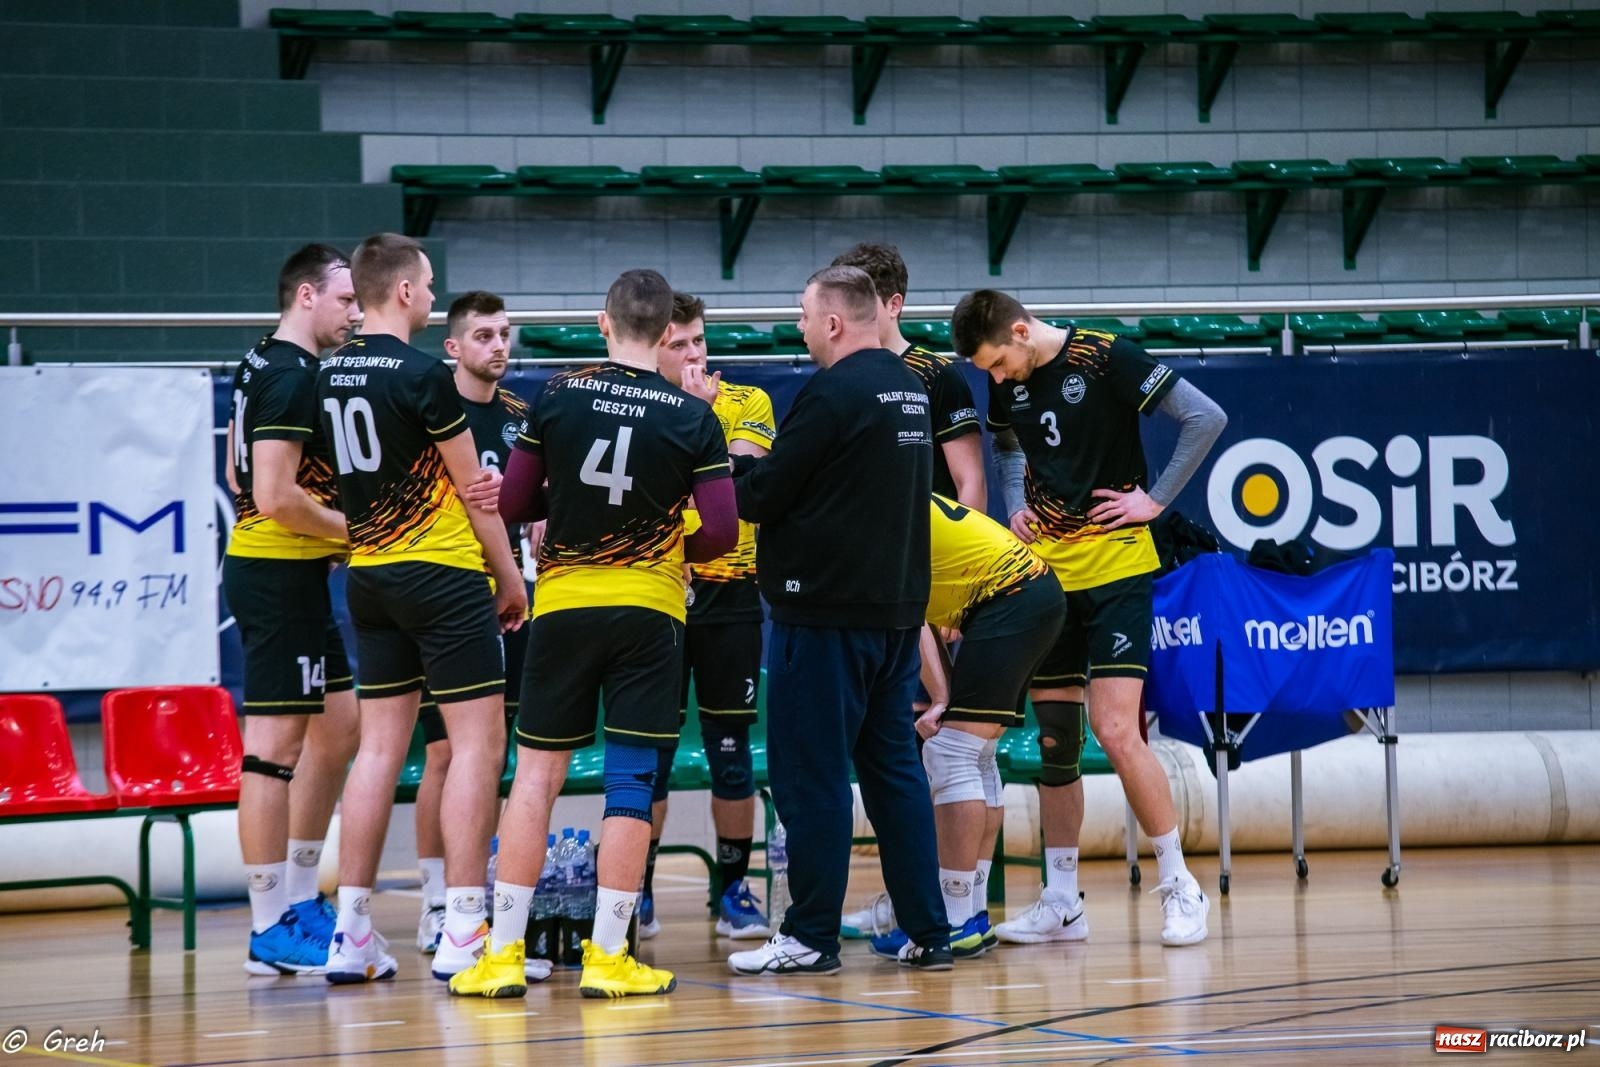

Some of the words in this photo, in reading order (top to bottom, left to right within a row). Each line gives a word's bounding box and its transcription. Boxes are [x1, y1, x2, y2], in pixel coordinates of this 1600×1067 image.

[330, 374, 368, 387] CIESZYN
[343, 356, 404, 370] SFERAWENT
[567, 378, 610, 393] TALENT
[610, 384, 685, 408] SFERAWENT
[592, 398, 646, 418] CIESZYN
[876, 391, 904, 404] TALENT
[323, 396, 382, 475] 10
[1040, 411, 1061, 447] 3
[579, 425, 634, 506] 4
[1391, 550, 1519, 593] CIBÓRZ
[71, 580, 128, 610] 94,9
[137, 573, 188, 609] FM
[1151, 615, 1203, 651] lten
[1244, 614, 1374, 651] molten
[297, 656, 327, 695] 14
